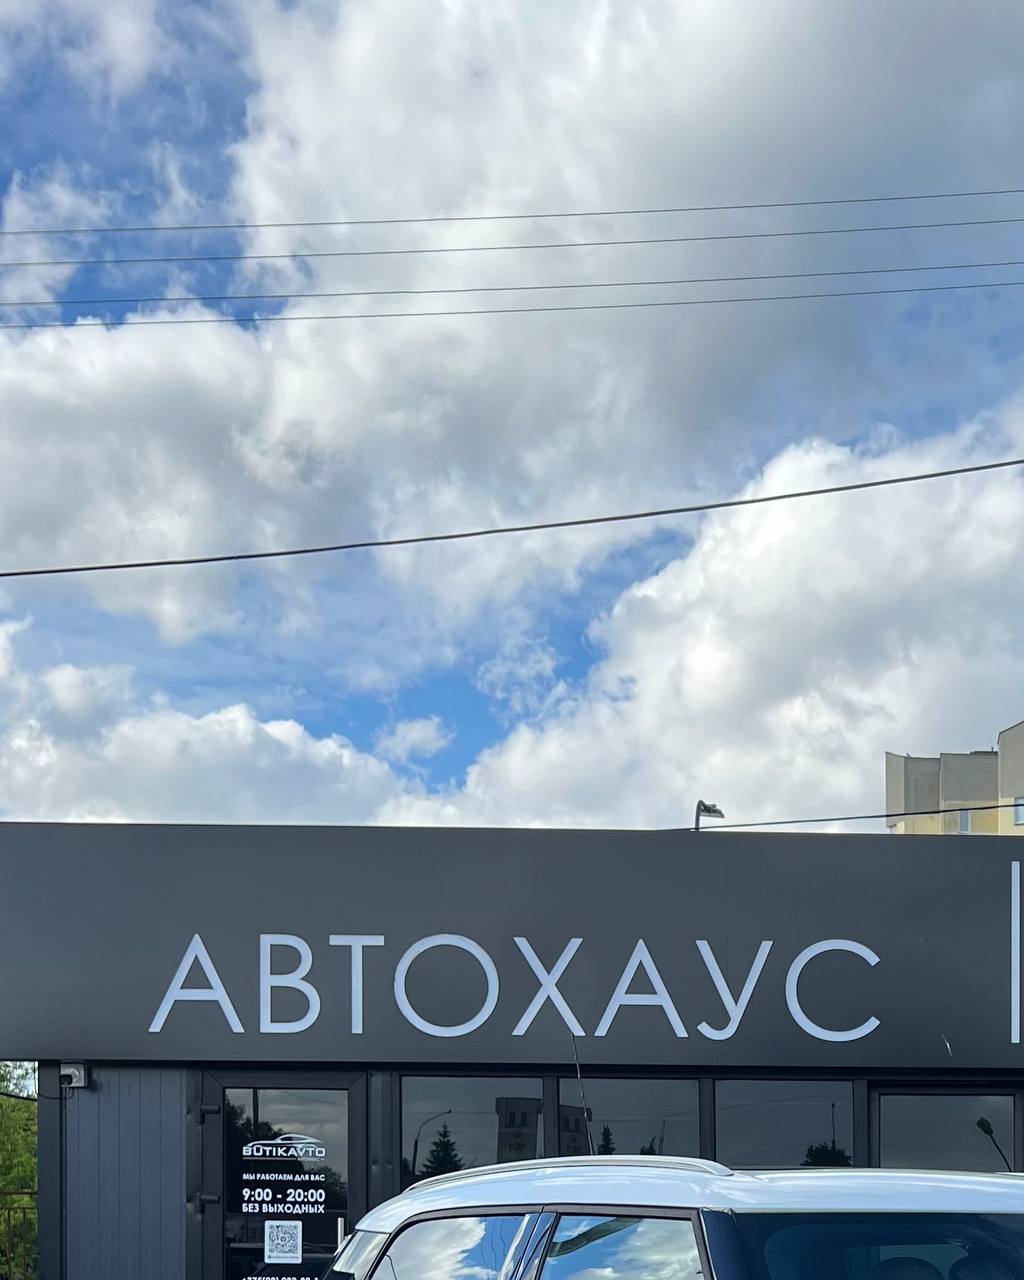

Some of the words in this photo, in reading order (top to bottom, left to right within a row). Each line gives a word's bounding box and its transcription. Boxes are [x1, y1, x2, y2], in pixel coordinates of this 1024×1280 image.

[148, 933, 882, 1043] АВТОХАУС
[242, 1147, 326, 1157] BUTIKAVTO
[242, 1173, 255, 1181] МЫ
[256, 1173, 293, 1181] РАБОТАЕМ
[293, 1174, 309, 1182] ДЛЯ
[310, 1174, 326, 1182] ВАС
[242, 1188, 272, 1201] 9:00
[286, 1189, 326, 1202] 20:00
[242, 1203, 259, 1213] БЕЗ
[262, 1204, 325, 1215] ВЫХОДНЫХ
